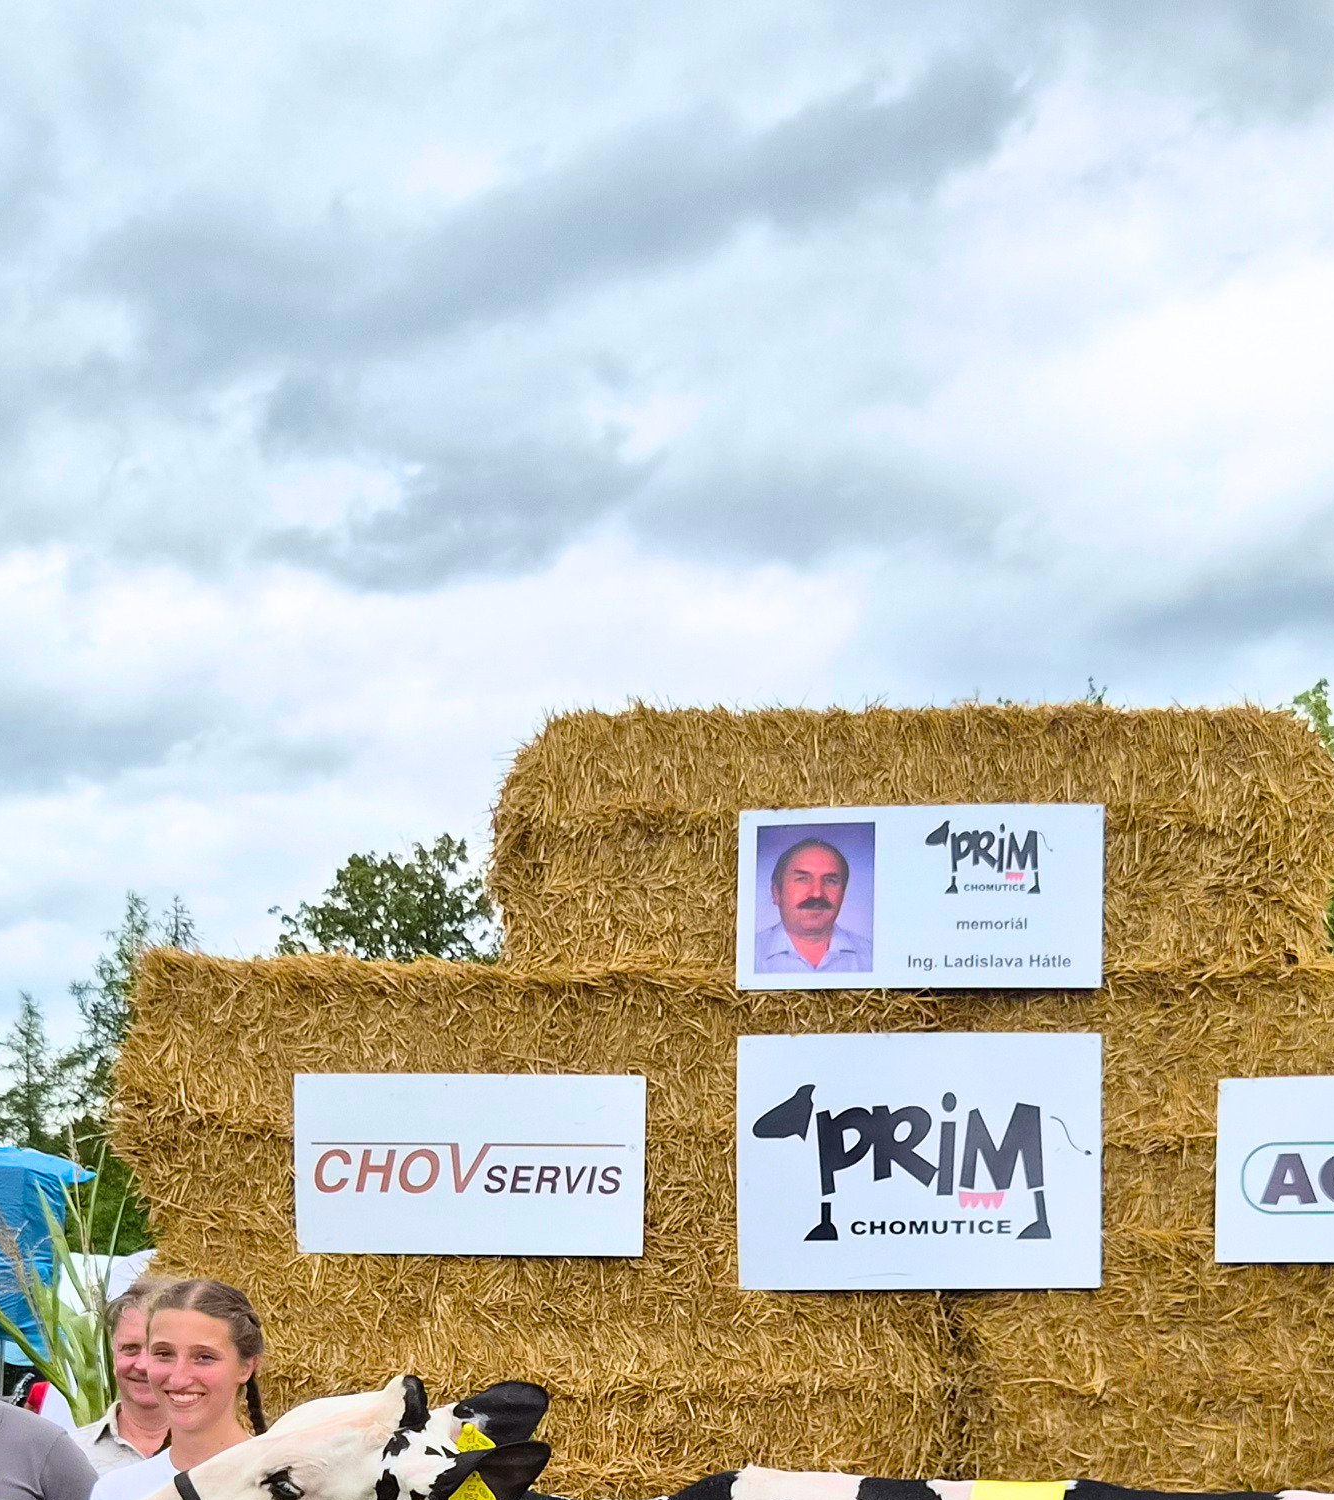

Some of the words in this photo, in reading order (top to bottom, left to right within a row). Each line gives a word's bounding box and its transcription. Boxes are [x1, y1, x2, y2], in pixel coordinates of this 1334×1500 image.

[963, 883, 1026, 892] CHOMUTICE
[955, 917, 1028, 930] memoriál
[907, 954, 938, 971] Ing.
[943, 954, 1024, 968] Ladislava
[1029, 954, 1072, 968] Hátle
[850, 1219, 1012, 1235] CHOMUTICE
